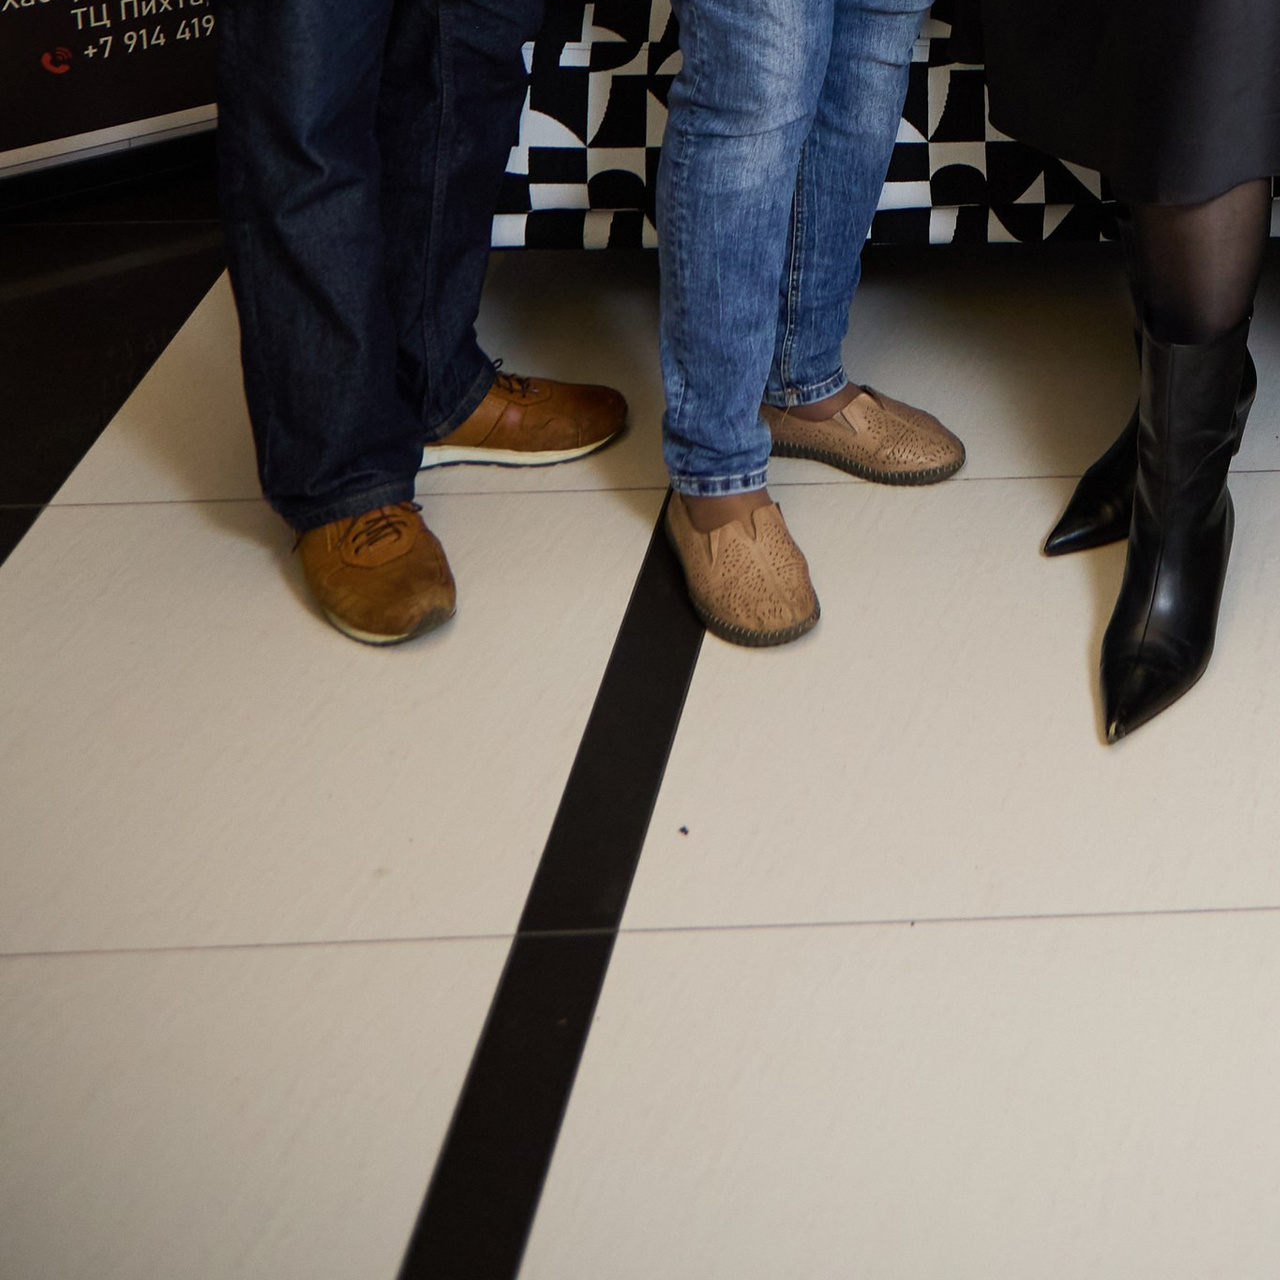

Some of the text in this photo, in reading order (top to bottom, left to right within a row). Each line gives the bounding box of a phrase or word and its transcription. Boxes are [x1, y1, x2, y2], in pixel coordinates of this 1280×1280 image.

[70, 2, 111, 30] ТЦ
[84, 14, 216, 59] +7 914 419
